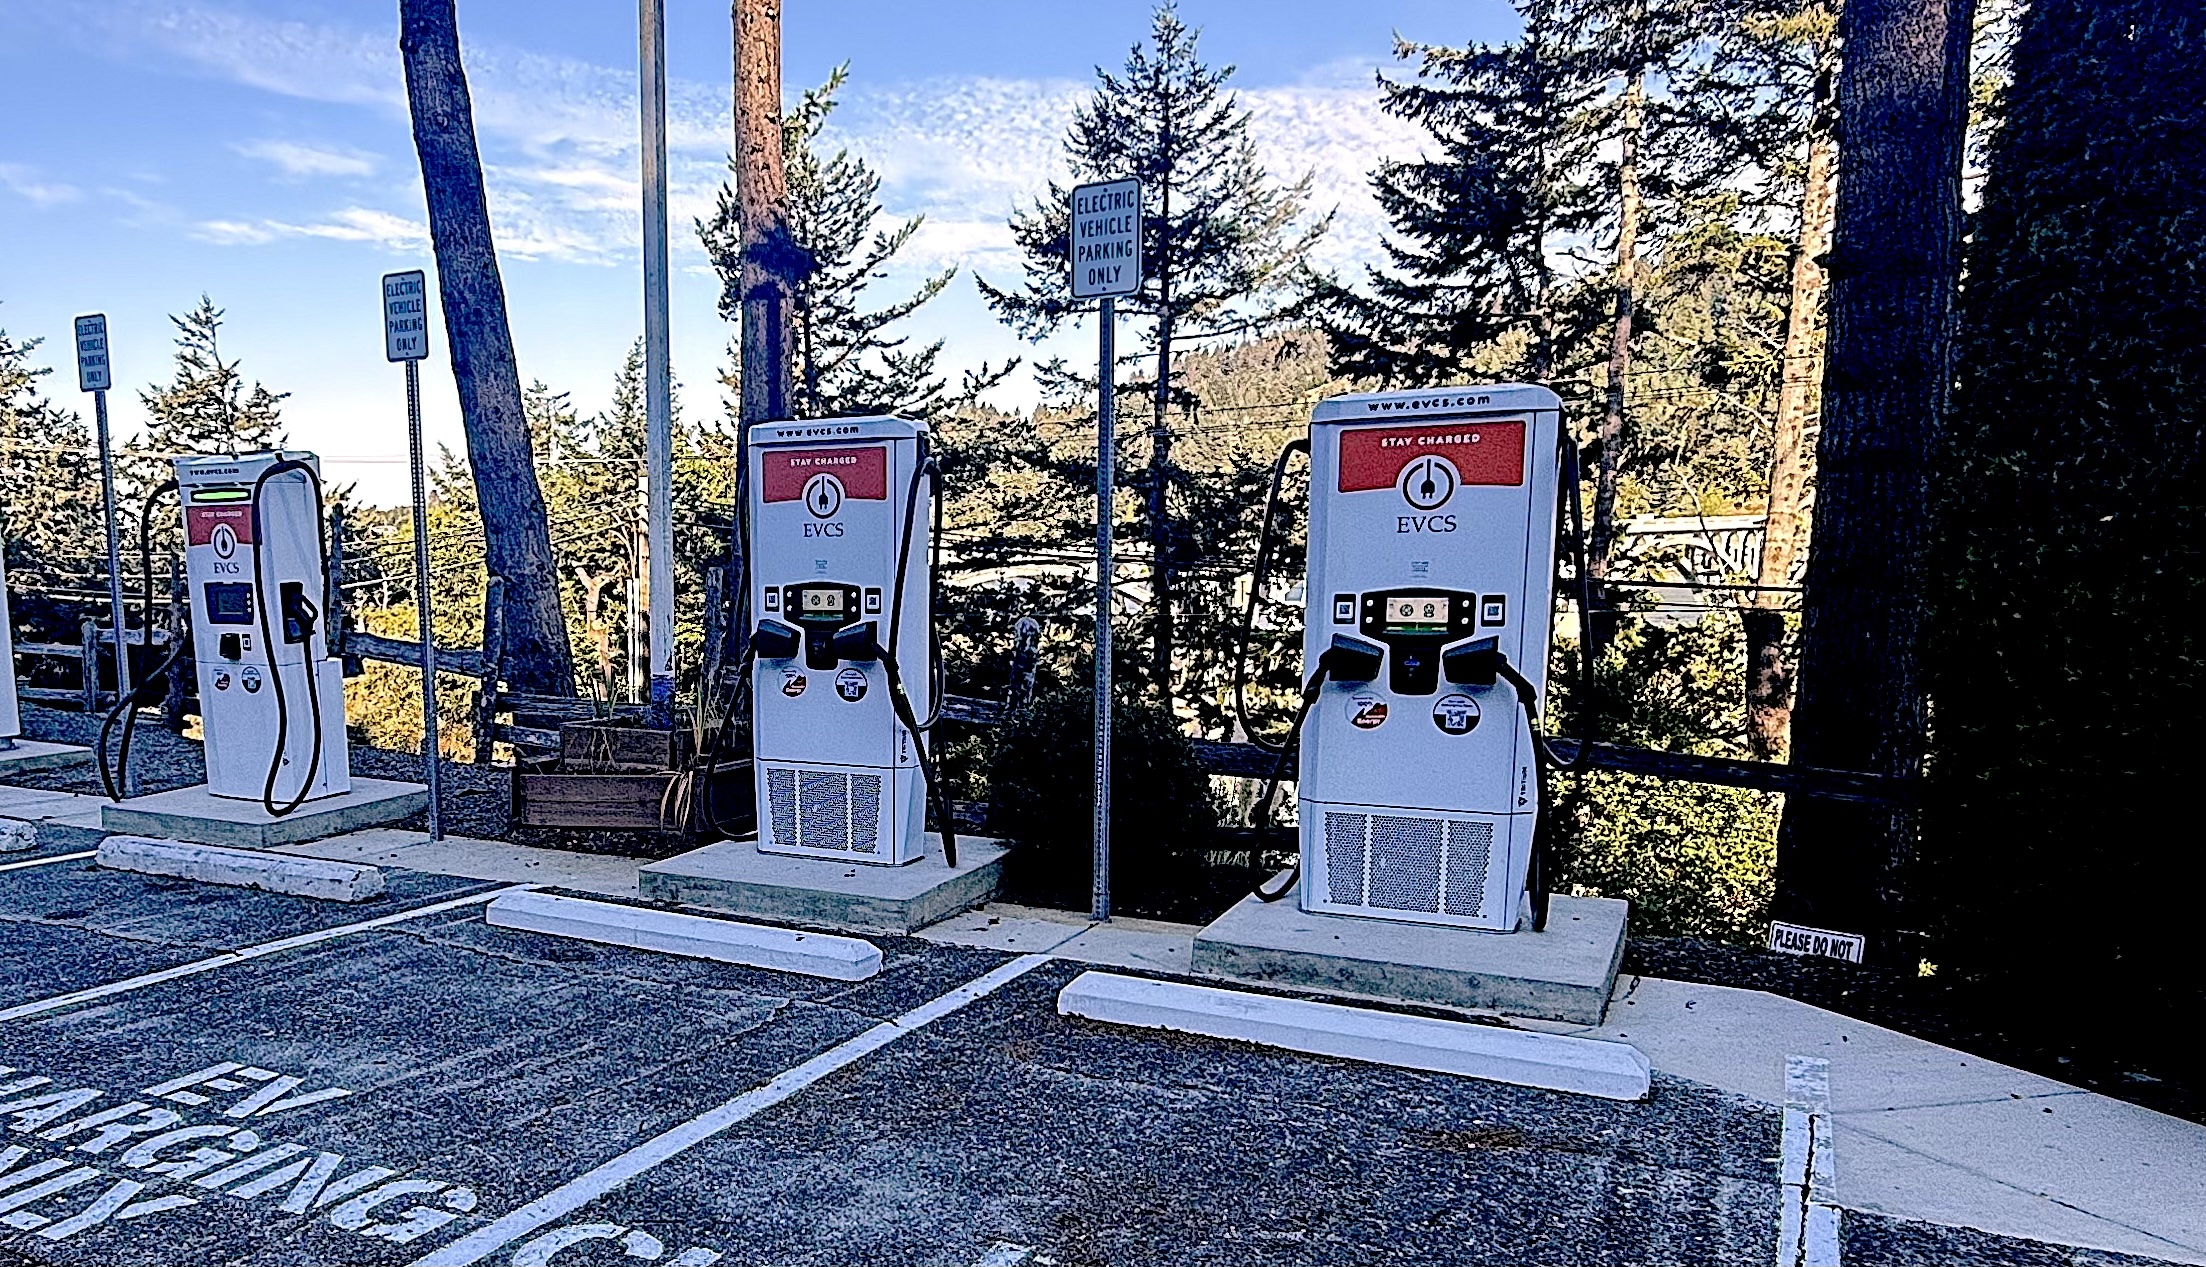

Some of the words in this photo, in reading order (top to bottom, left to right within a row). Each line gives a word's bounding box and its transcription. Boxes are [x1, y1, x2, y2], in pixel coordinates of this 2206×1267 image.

[1078, 190, 1135, 215] ELECTRIC
[1080, 215, 1132, 238] VEHICLE
[1078, 240, 1132, 262] PARKING
[1088, 265, 1121, 285] ONLY
[386, 280, 421, 297] ELECTRIC
[388, 299, 421, 315] VEHICLE
[389, 317, 422, 334] PARKING
[396, 336, 417, 351] ONLY
[1368, 395, 1490, 411] www.evcs.com
[1381, 437, 1413, 447] STAY
[1417, 434, 1480, 446] CHARGED
[790, 458, 812, 467] STAY
[814, 456, 857, 466] CHARGED
[803, 522, 844, 538] EVCS
[1396, 515, 1457, 533] EVCS
[213, 562, 240, 575] EVCS
[1774, 928, 1811, 953] PLEASE
[1812, 935, 1828, 956] DO
[1829, 938, 1854, 960] NOT
[141, 1060, 352, 1118] EV
